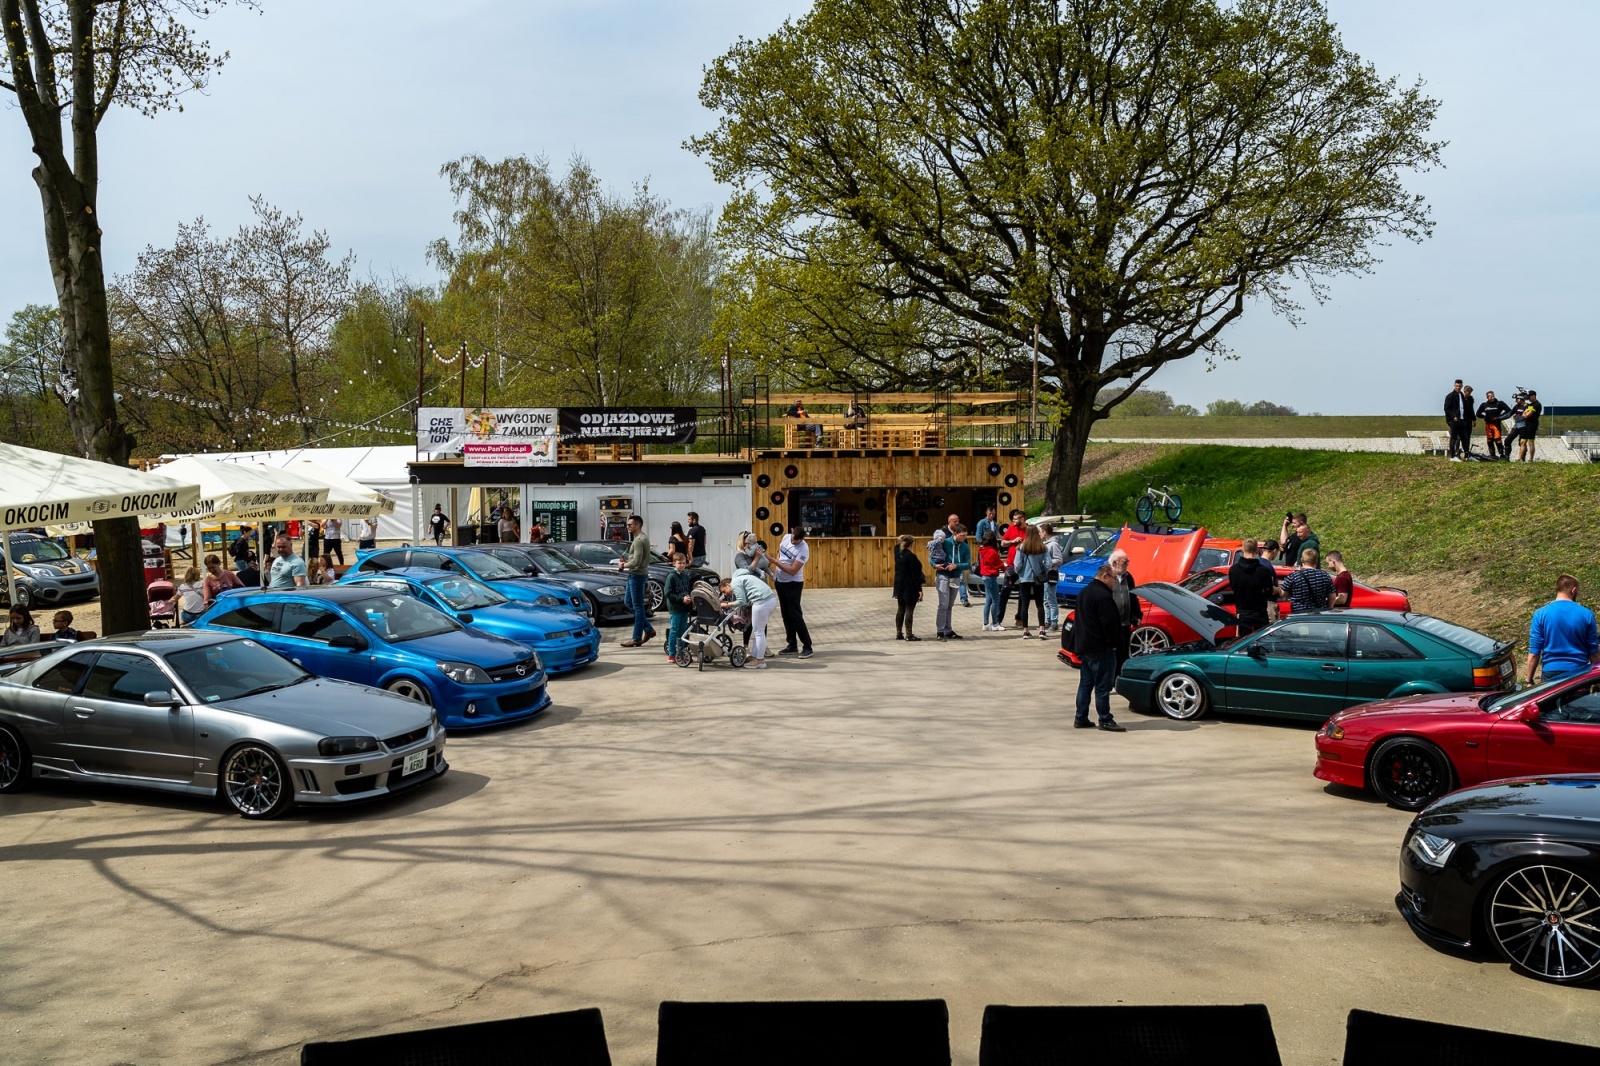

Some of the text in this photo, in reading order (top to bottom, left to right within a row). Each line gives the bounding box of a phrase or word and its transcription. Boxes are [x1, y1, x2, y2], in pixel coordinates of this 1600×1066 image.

[430, 417, 453, 426] CHE
[496, 413, 552, 424] WYGODNE
[580, 413, 675, 426] ODJAZDOWE
[430, 426, 454, 435] MOT
[502, 426, 547, 437] ZAKUPY
[580, 426, 675, 438] NAKLEJKI.PL
[430, 434, 450, 443] ION
[251, 493, 280, 505] OKOCIM
[5, 502, 69, 525] OKOCIM
[121, 492, 178, 512] OKOCIM
[534, 502, 560, 510] Konopie
